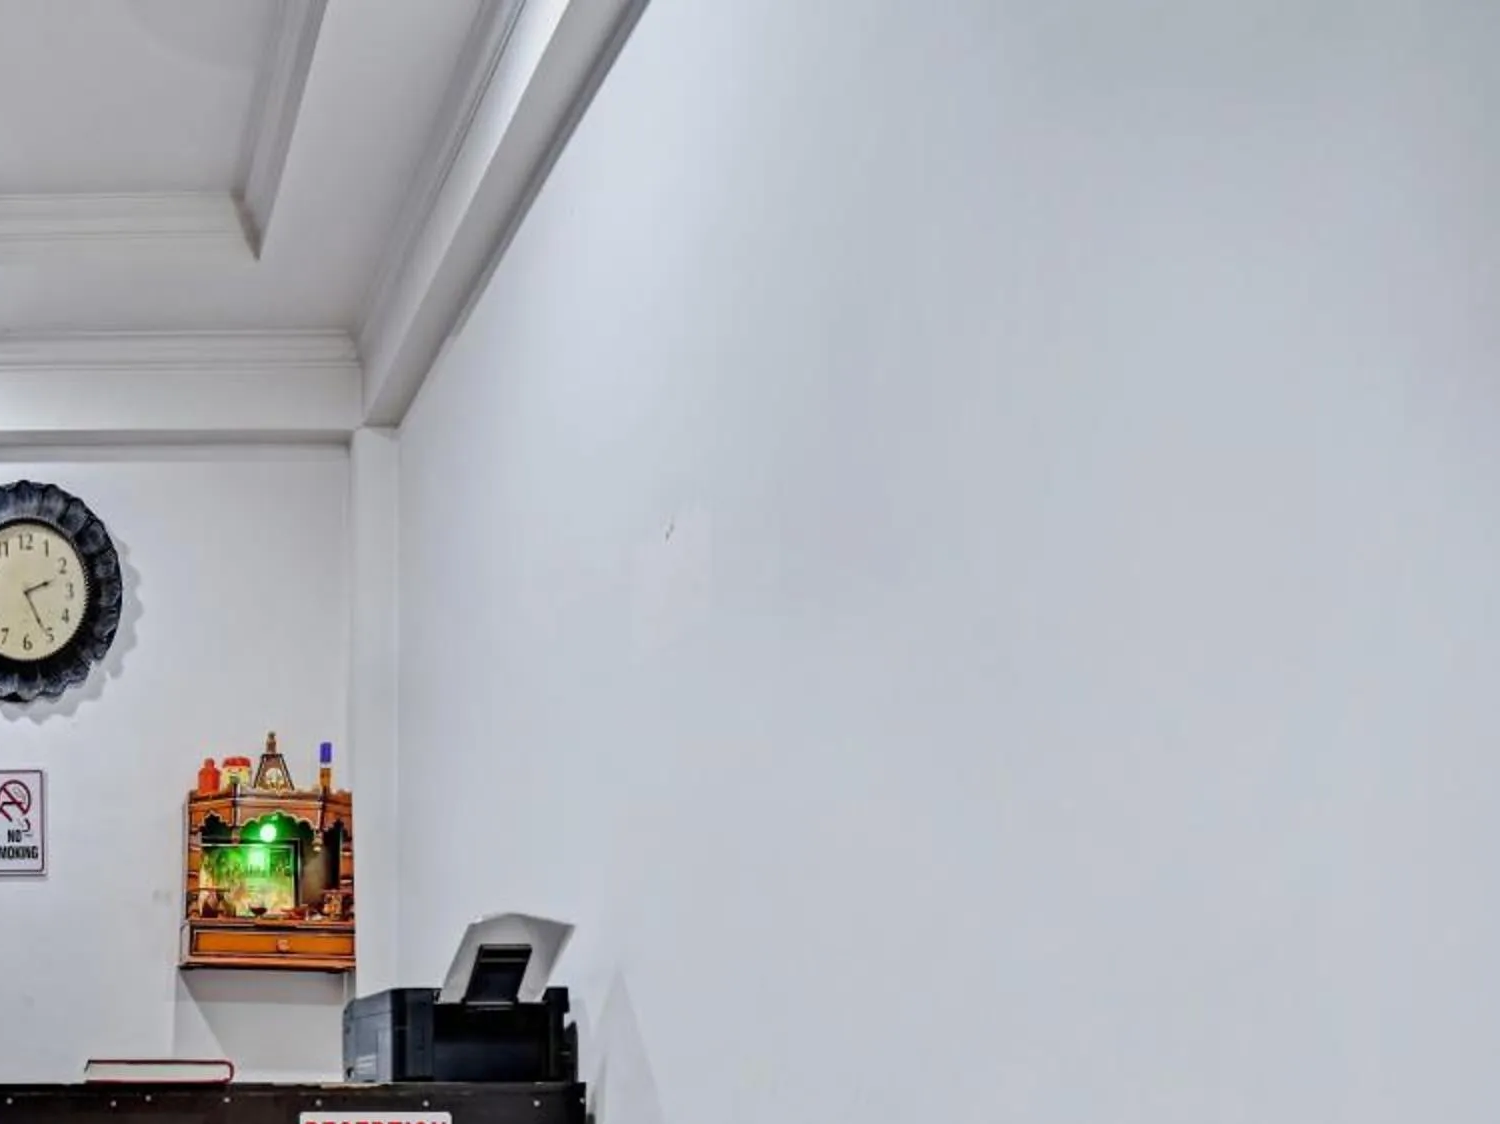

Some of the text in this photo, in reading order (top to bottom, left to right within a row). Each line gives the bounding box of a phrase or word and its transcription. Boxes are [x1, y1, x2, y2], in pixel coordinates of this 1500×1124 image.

[18, 533, 33, 550] 12
[43, 539, 50, 557] 1
[57, 557, 67, 574] 2
[65, 583, 75, 599] 3
[61, 608, 70, 624] 4
[1, 628, 9, 645] 7
[23, 635, 33, 651] 6
[46, 627, 55, 643] 5
[7, 829, 22, 843] NO
